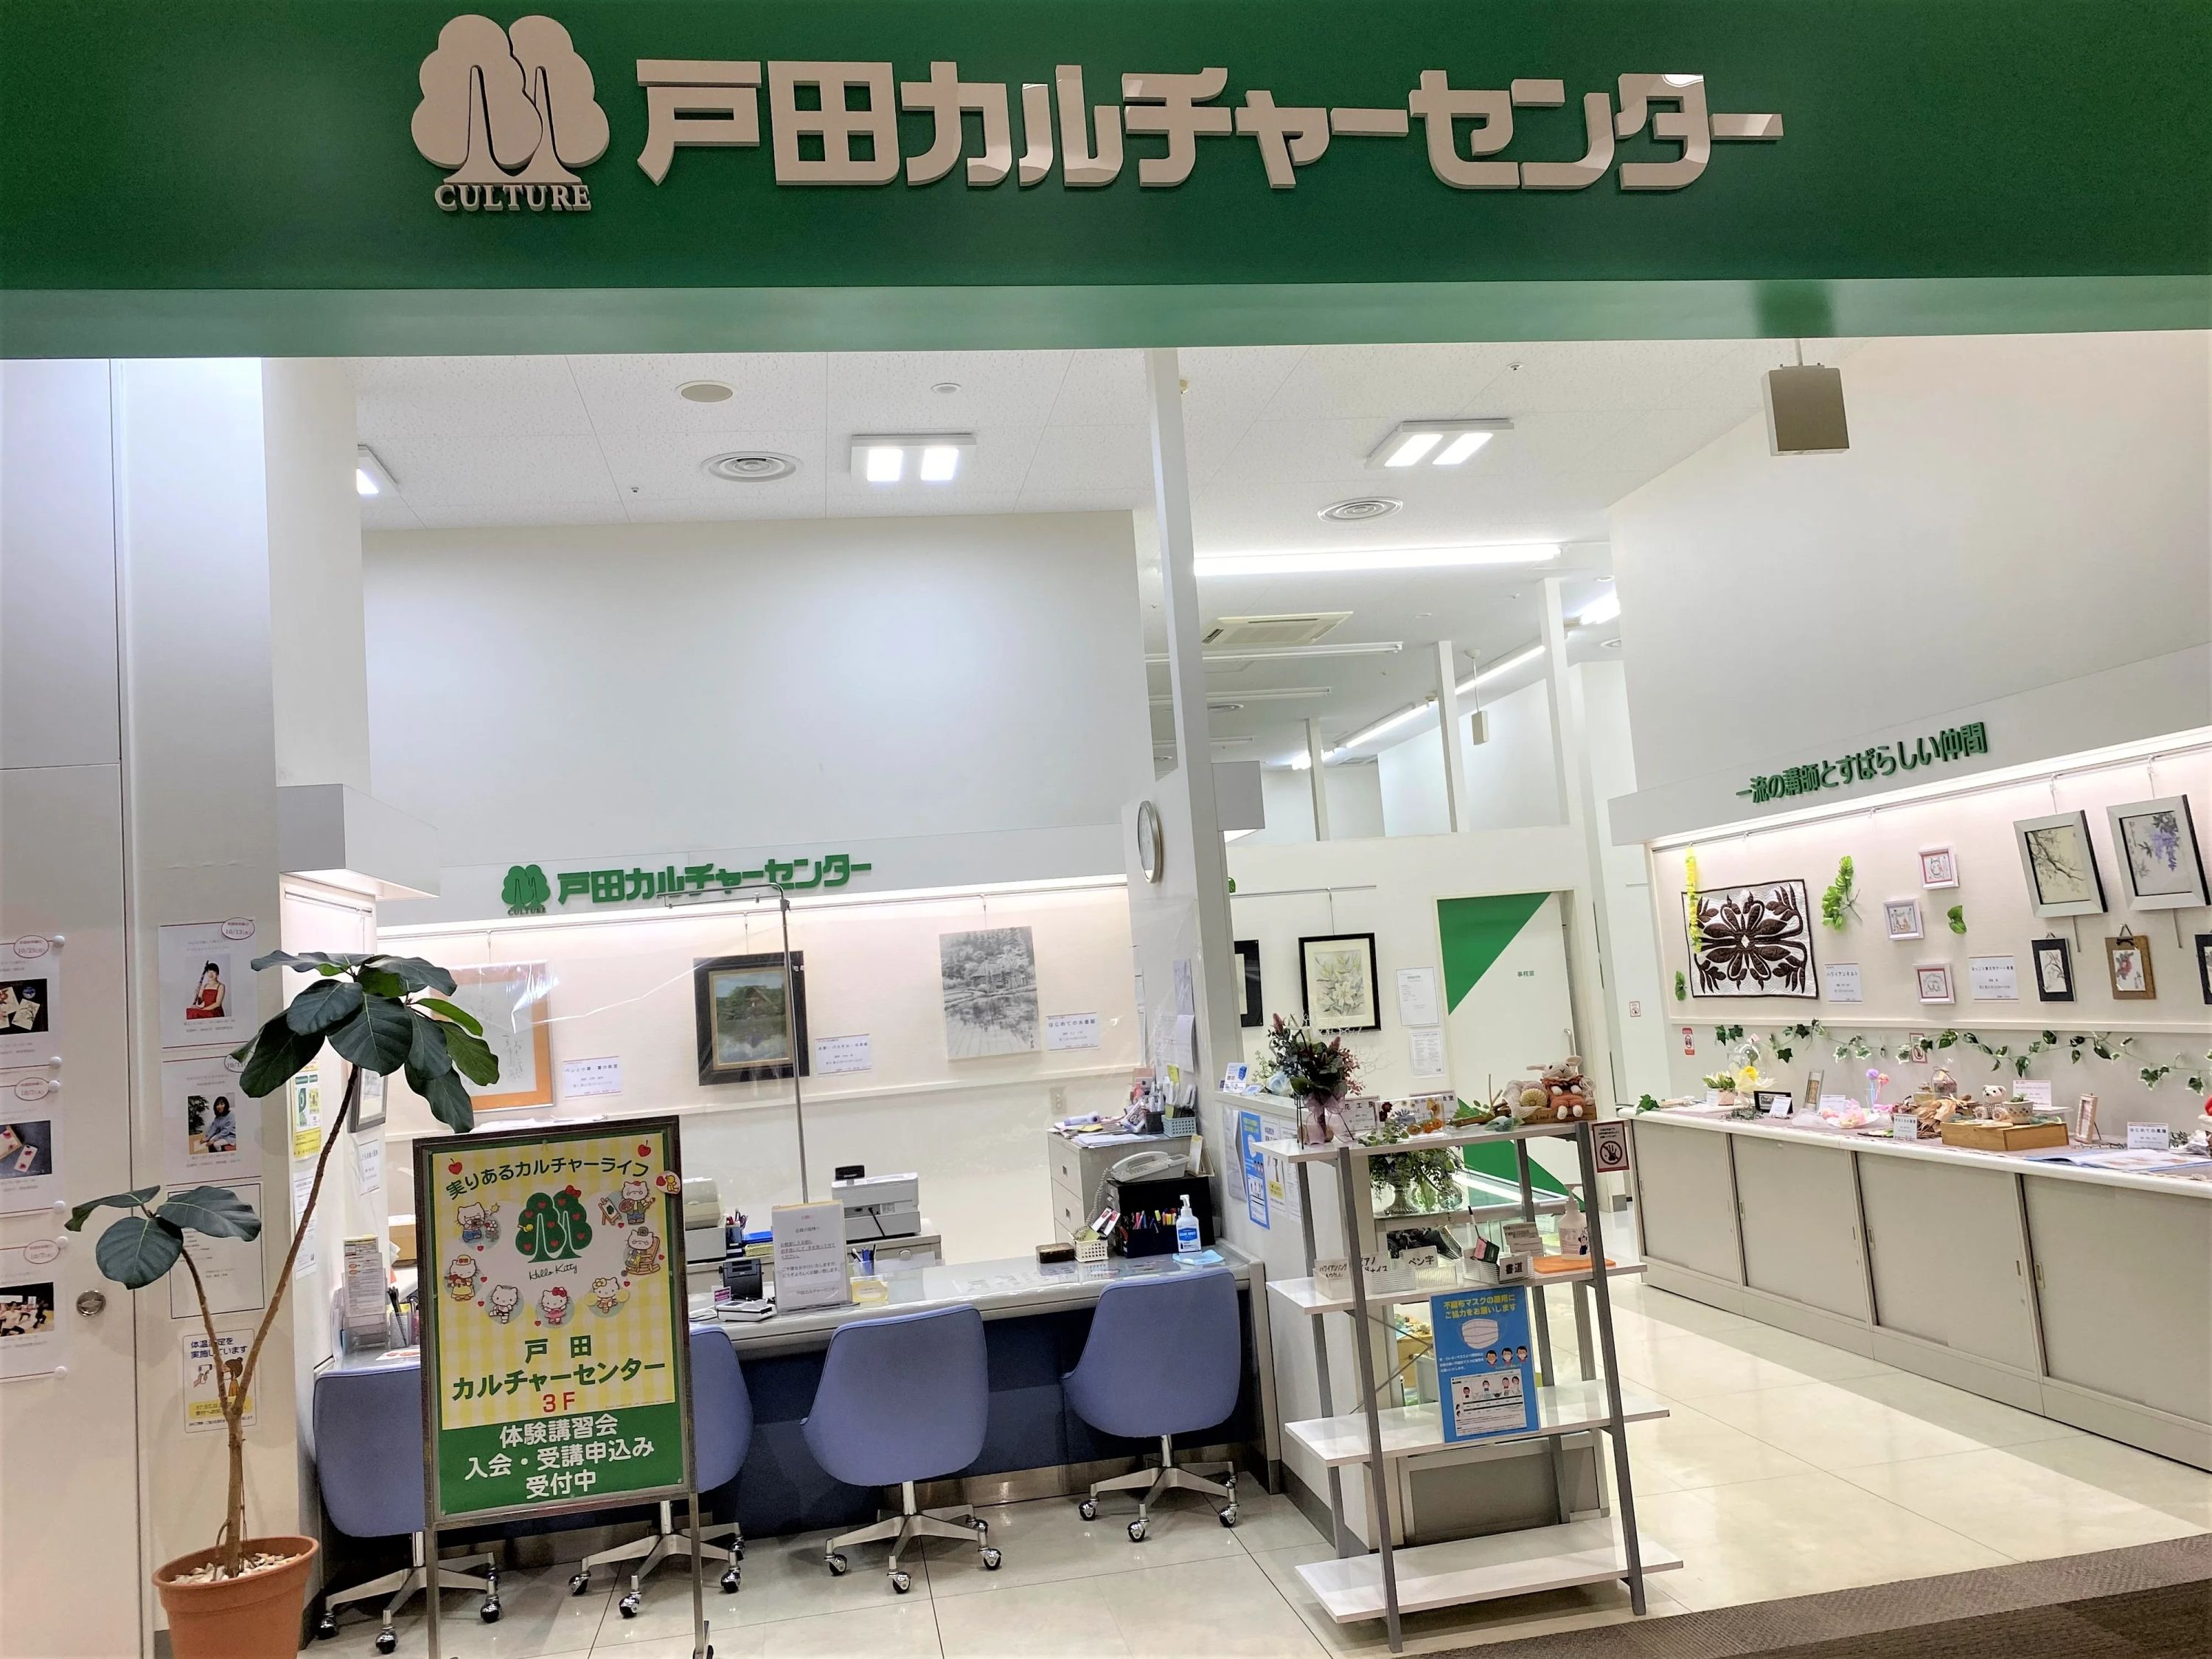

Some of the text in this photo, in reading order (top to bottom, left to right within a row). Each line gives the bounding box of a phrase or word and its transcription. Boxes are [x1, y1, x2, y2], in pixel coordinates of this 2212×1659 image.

[636, 59, 1783, 190] 戸田カルチャーセンター
[434, 184, 591, 212] CULTURE
[1736, 722, 1988, 803] 一流の講師とすばらしい仲間
[557, 854, 872, 905] 戸田カルチャーセンター
[507, 907, 547, 916] CULTURE
[446, 1158, 649, 1200] 実りあるカルチャーライフ
[529, 1263, 578, 1281] Hello Kitty
[1408, 1255, 1434, 1266] ペン字
[1506, 1262, 1523, 1274] 書道
[1445, 1304, 1516, 1319] ご協力をお願いします
[190, 1338, 233, 1349] 体温定を
[524, 1335, 591, 1364] 戸田
[452, 1358, 665, 1401] カルチャーセンター
[543, 1391, 575, 1413] 3F
[499, 1413, 618, 1449] 体験講習会
[465, 1437, 654, 1481] 入会・受講申込み
[526, 1469, 596, 1500] 受付中
